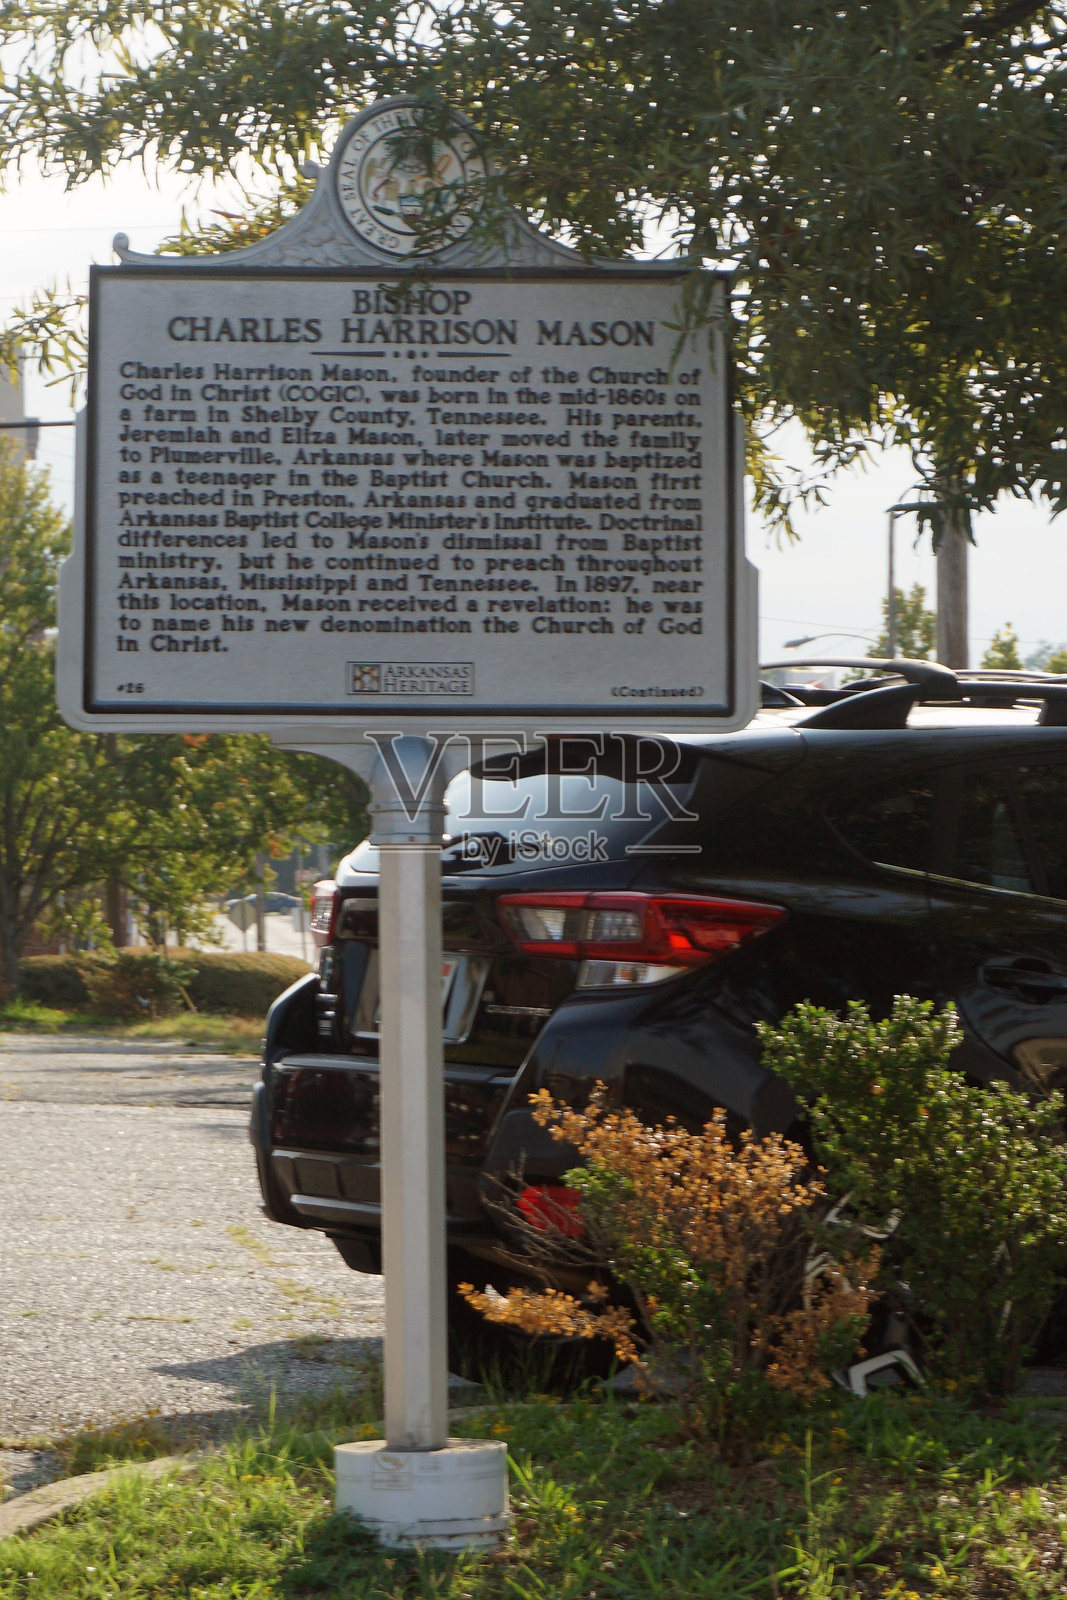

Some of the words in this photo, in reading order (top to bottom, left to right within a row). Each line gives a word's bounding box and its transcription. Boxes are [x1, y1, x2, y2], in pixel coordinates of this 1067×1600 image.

[352, 289, 472, 315] BISHOP
[167, 315, 323, 343] CHARLES
[341, 317, 518, 345] HARRISON
[536, 319, 655, 346] MASON
[119, 363, 205, 379] Charles
[213, 364, 314, 380] Harrison
[411, 366, 501, 382] founder
[508, 367, 533, 383] of
[540, 367, 580, 383] the
[587, 368, 673, 384] Church
[678, 368, 701, 384] of
[119, 384, 163, 400] God
[170, 385, 193, 401] in
[199, 385, 271, 401] Christ
[379, 390, 421, 402] was
[427, 387, 480, 403] born
[486, 387, 509, 403] in
[514, 388, 552, 404] the
[558, 388, 667, 404] mid-1860s
[674, 393, 701, 405] on
[119, 410, 132, 422] a
[143, 406, 198, 422] farm
[206, 406, 230, 422] in
[240, 407, 320, 427] Shelby
[425, 408, 547, 424] Tennessee.
[565, 409, 603, 425] His
[118, 426, 222, 442] Jeremiah
[229, 427, 272, 443] and
[280, 428, 338, 444] Eliza
[434, 429, 490, 445] later
[501, 430, 571, 446] moved
[581, 430, 619, 446] the
[629, 431, 702, 451] family
[119, 448, 142, 464] to
[292, 449, 395, 465] Arkansas
[402, 449, 474, 465] where
[481, 450, 550, 466] Mason
[556, 454, 597, 466] was
[604, 451, 703, 471] baptized
[118, 472, 142, 484] as
[150, 472, 164, 484] a
[174, 469, 277, 489] teenager
[287, 469, 311, 485] in
[321, 470, 359, 486] the
[369, 470, 449, 490] Baptist
[460, 471, 552, 487] Church.
[568, 472, 638, 488] Mason
[650, 473, 702, 489] first
[118, 489, 226, 509] preached
[231, 490, 254, 506] in
[363, 492, 467, 508] Arkansas
[473, 492, 517, 508] and
[524, 493, 642, 513] graduated
[649, 494, 702, 510] from
[118, 510, 219, 526] Arkansas
[223, 511, 300, 531] Baptist
[304, 512, 384, 532] College
[386, 512, 491, 528] Minister's
[493, 513, 593, 529] Institute.
[598, 514, 703, 530] Doctrinal
[117, 531, 249, 547] differences
[261, 532, 298, 548] led
[310, 532, 334, 548] to
[347, 533, 430, 549] Mason's
[442, 533, 542, 549] dismissal
[555, 534, 609, 550] from
[622, 534, 703, 554] Baptist
[238, 553, 275, 569] but
[285, 553, 314, 569] he
[324, 554, 440, 570] continued
[451, 554, 475, 570] to
[484, 554, 566, 574] preach
[576, 555, 703, 575] throughout
[238, 574, 357, 594] Mississippi
[366, 574, 409, 590] and
[416, 575, 539, 591] Tennessee.
[555, 576, 578, 592] In
[652, 580, 704, 592] near
[117, 594, 160, 610] this
[281, 595, 352, 611] Mason
[357, 595, 458, 611] received
[465, 600, 479, 612] a
[487, 596, 611, 612] revelation:
[625, 597, 654, 613] he
[662, 601, 703, 613] was
[118, 615, 142, 631] to
[151, 619, 211, 631] name
[221, 615, 255, 631] his
[264, 619, 310, 631] new
[319, 616, 472, 632] denomination
[482, 616, 520, 632] the
[531, 617, 615, 633] Church
[623, 617, 646, 633] of
[657, 617, 703, 633] God
[116, 636, 139, 652] in
[149, 636, 229, 652] Christ.
[384, 666, 470, 679] ARKANSAS
[384, 680, 470, 693] HERITAGE
